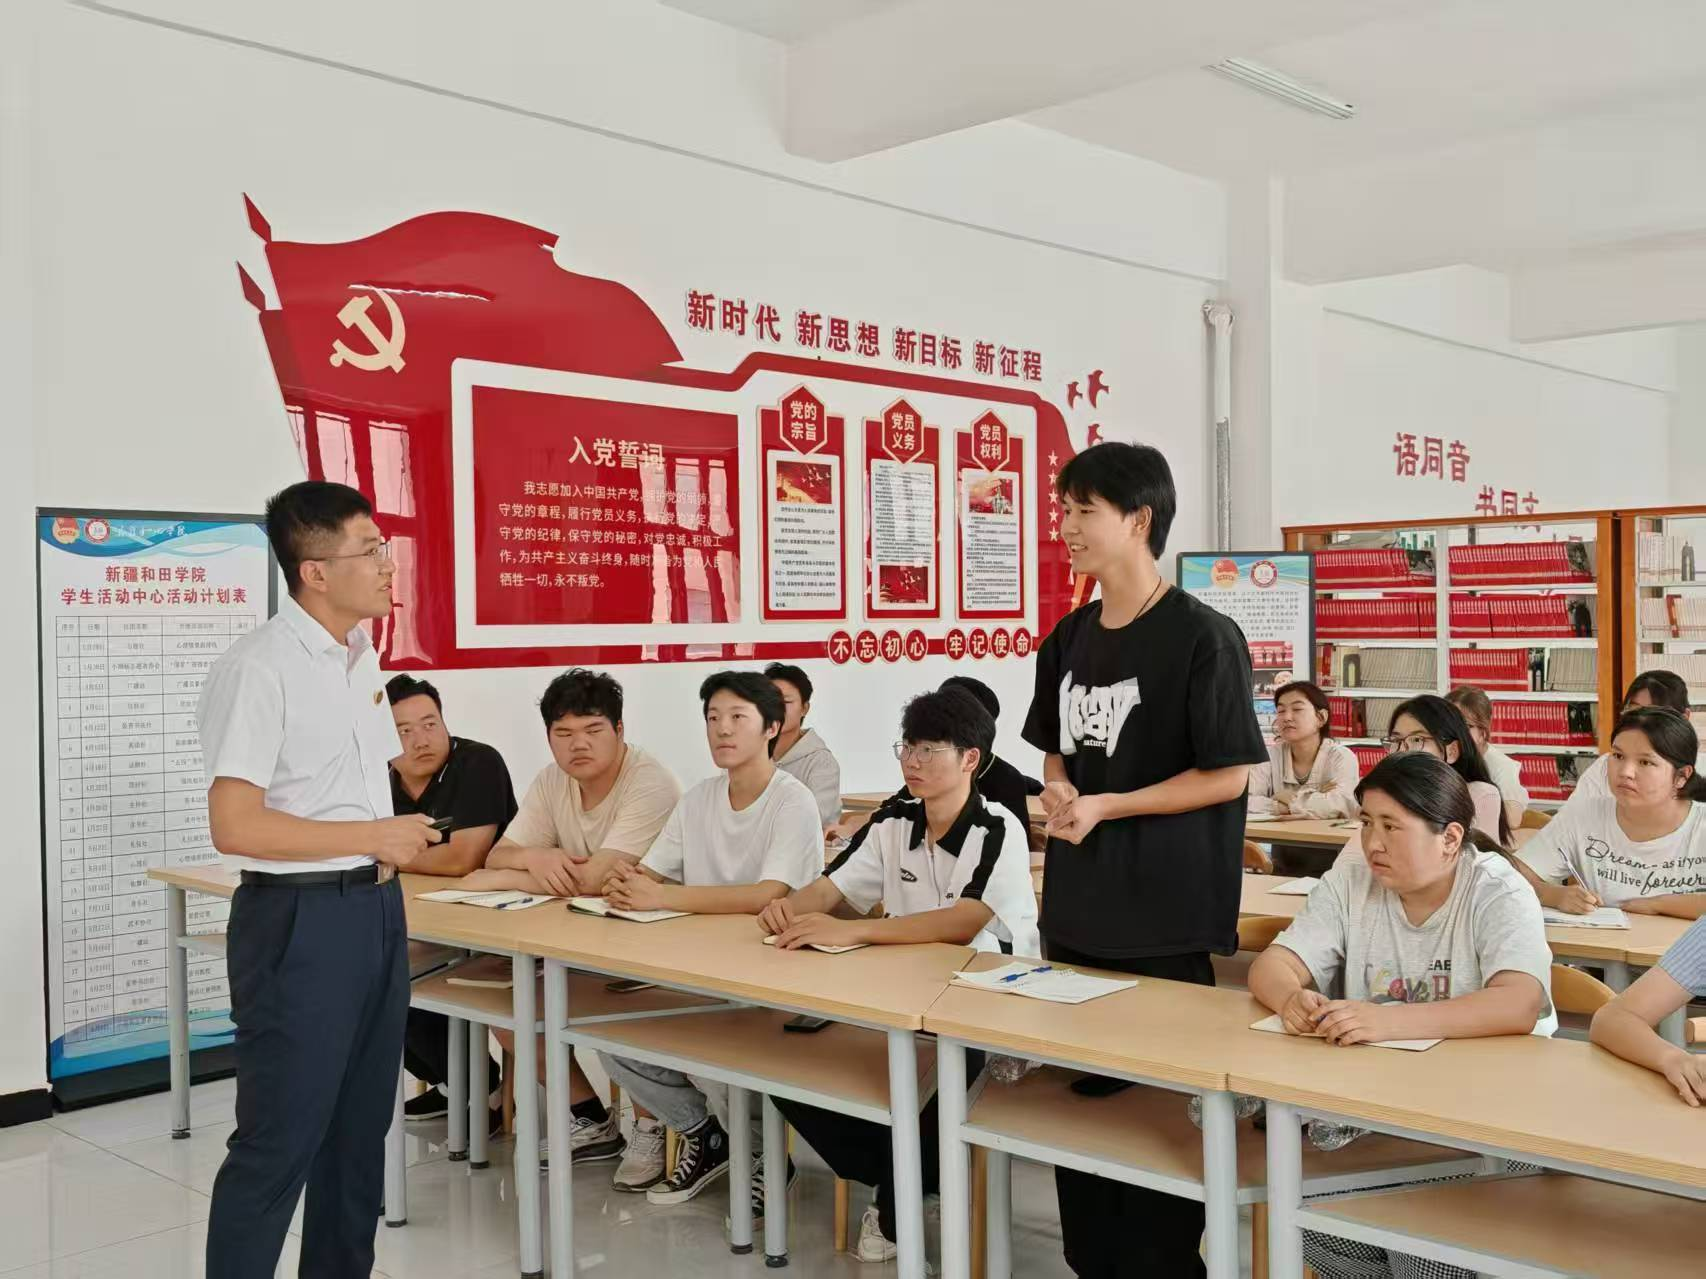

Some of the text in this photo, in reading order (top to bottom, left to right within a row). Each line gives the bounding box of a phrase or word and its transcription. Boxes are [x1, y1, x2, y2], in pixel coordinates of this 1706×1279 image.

[687, 290, 1042, 381] 新时代 新思想 新目标 新征程
[790, 400, 817, 420] 党的
[791, 421, 817, 441] 宗旨
[892, 412, 915, 431] 党员
[892, 432, 915, 451] 义务
[981, 424, 1001, 442] 党员
[568, 436, 666, 470] 入党誓词
[981, 442, 1002, 460] 权利
[1393, 432, 1470, 482] 语同音
[105, 566, 207, 583] 新疆和田学院
[61, 588, 248, 605] 学生活动中心活动计划表
[832, 634, 1030, 658] 不忘初心 牢记使命
[1662, 860, 1675, 869] as
[1597, 868, 1706, 895] will live forever
